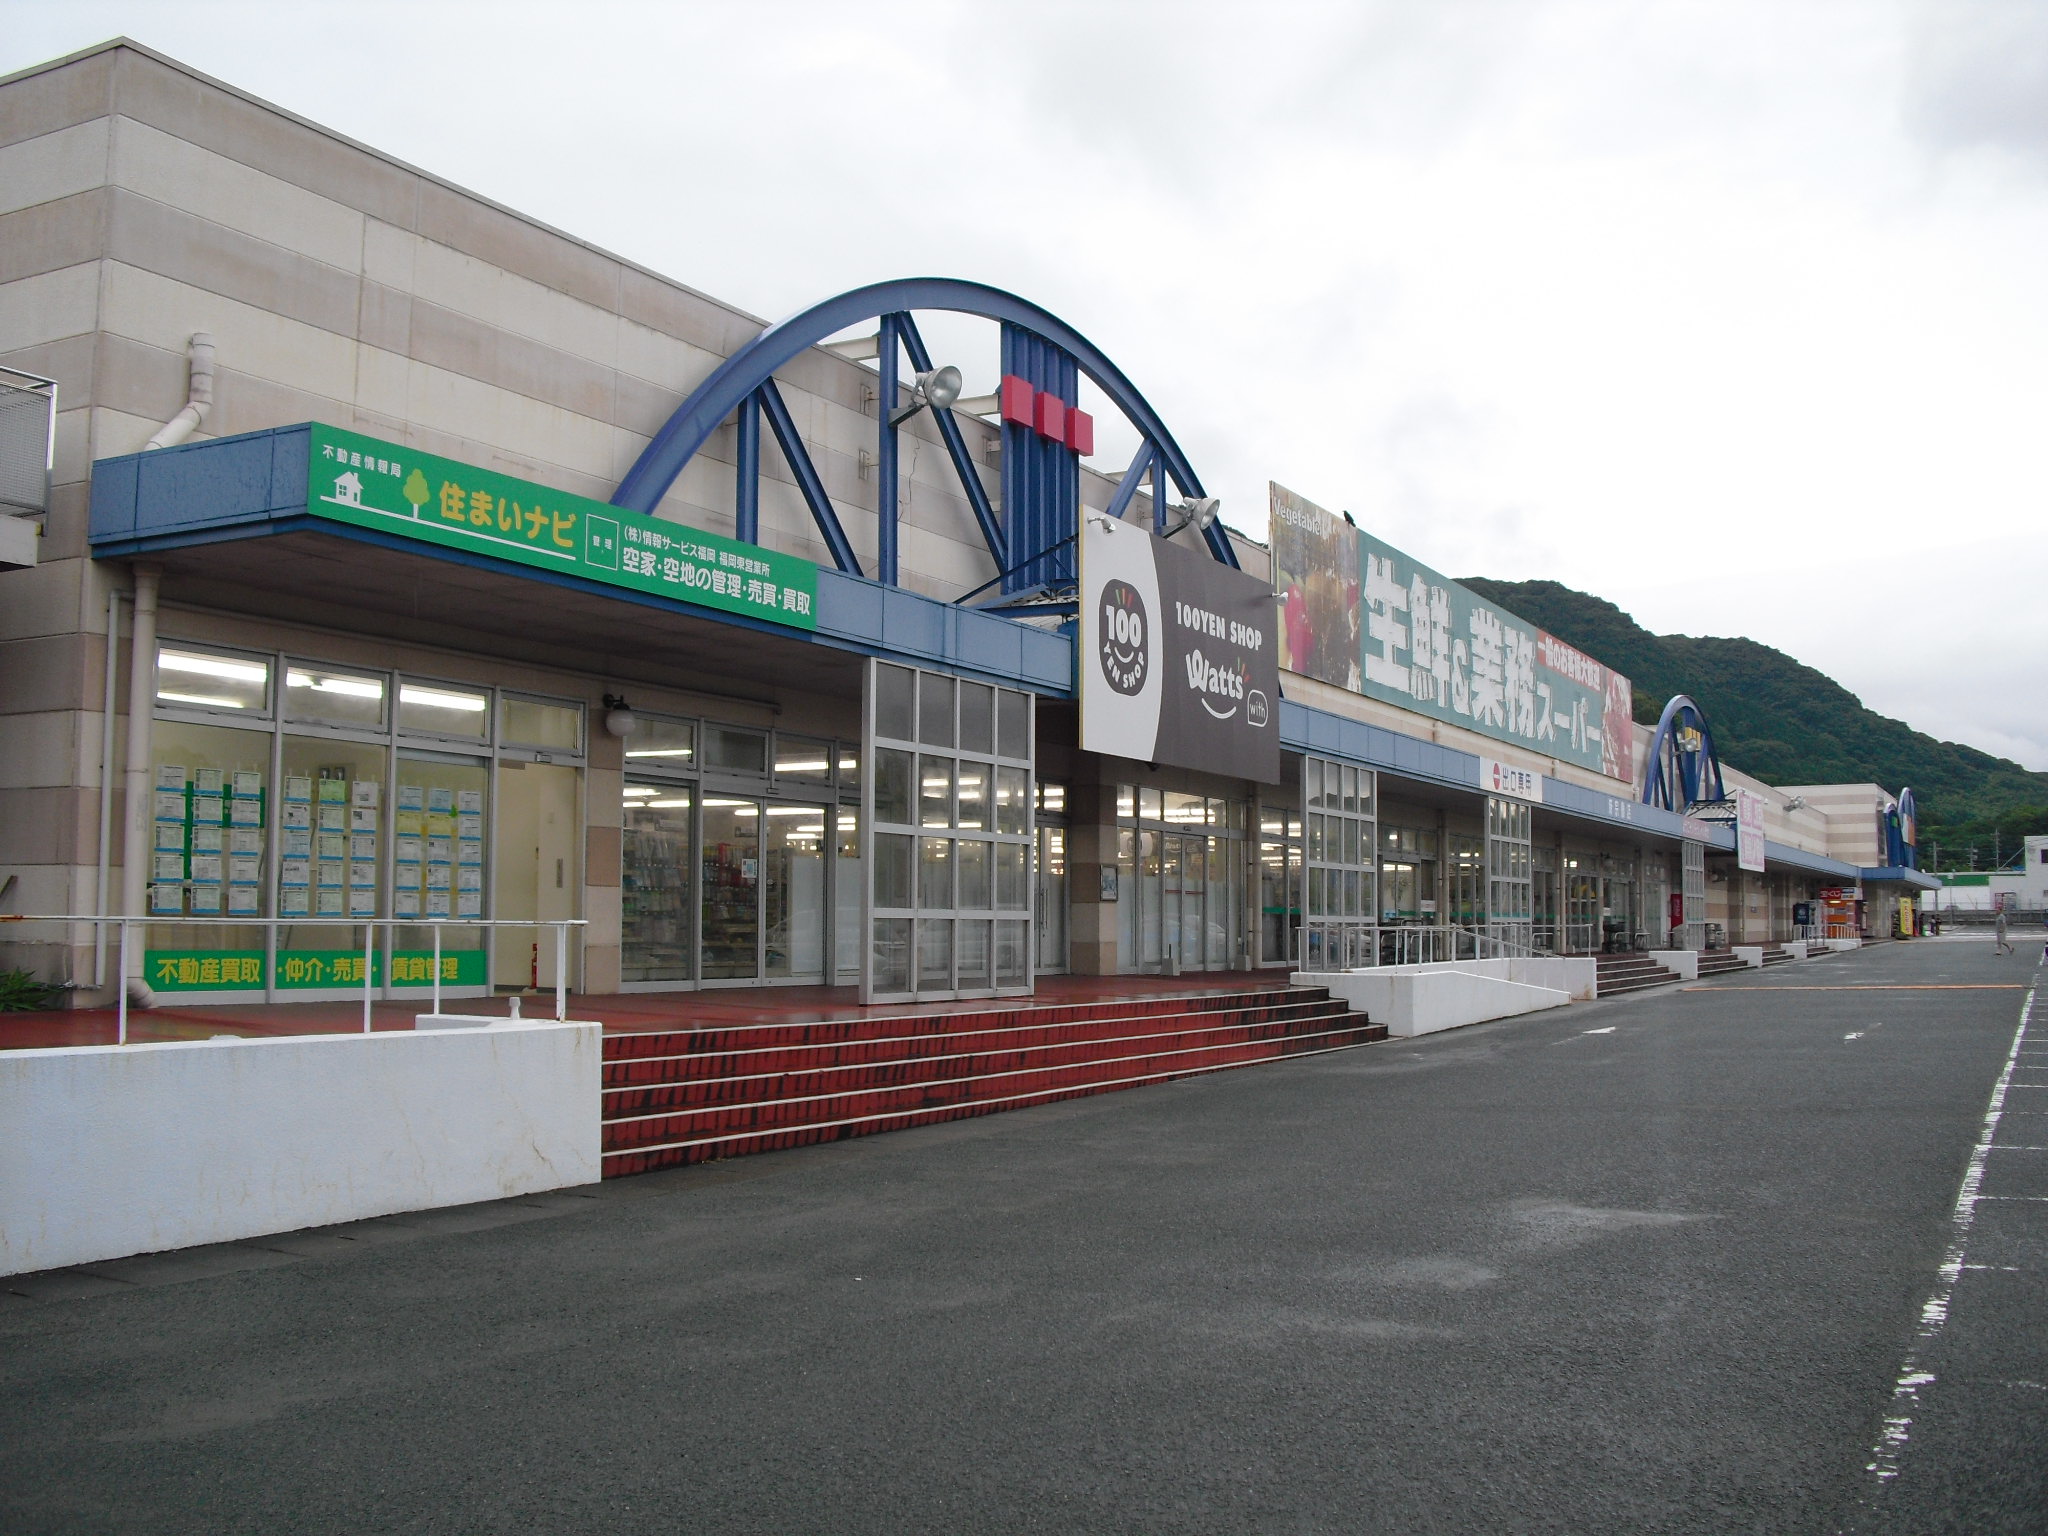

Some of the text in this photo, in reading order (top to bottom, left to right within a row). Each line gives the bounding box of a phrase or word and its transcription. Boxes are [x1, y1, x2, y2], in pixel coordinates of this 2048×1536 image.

[322, 444, 402, 478] 不動産情報局
[439, 480, 577, 548] 住まいナビ
[1105, 605, 1142, 648] 100
[1175, 601, 1263, 651] 100YEN SHOP
[1104, 642, 1145, 688] YEN SHOP
[1185, 648, 1244, 700] Watts
[1249, 701, 1266, 719] with
[1502, 767, 1532, 796] 出口専用
[156, 958, 260, 985] 不動産買取
